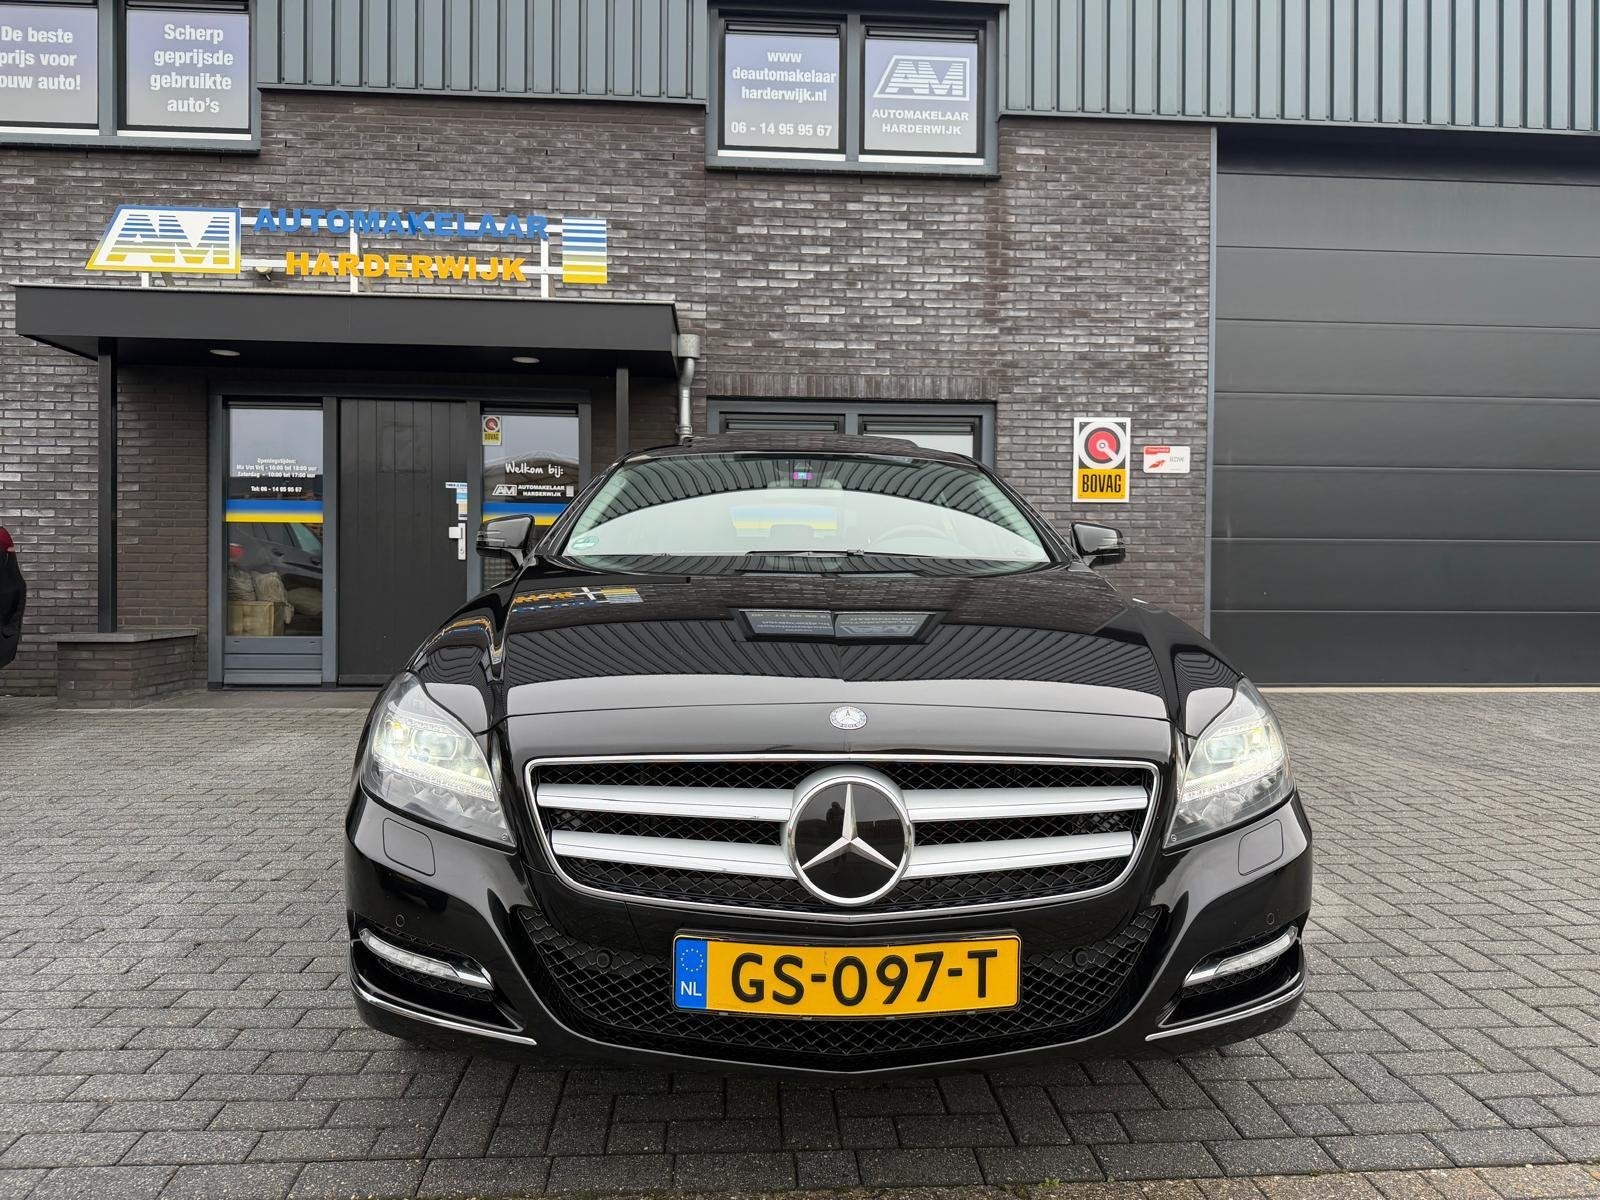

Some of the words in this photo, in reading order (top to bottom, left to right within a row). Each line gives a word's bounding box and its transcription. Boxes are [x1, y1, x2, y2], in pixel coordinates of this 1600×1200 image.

[1, 26, 23, 42] De
[28, 27, 73, 43] beste
[164, 24, 224, 43] Scherp
[0, 50, 35, 67] prijs
[40, 54, 77, 66] voor
[154, 50, 234, 67] geprijsde
[767, 51, 802, 63] www
[0, 75, 33, 89] ouw
[38, 75, 81, 90] auto!
[150, 72, 232, 91] gebruikte
[732, 67, 836, 84] deautomakelaar
[741, 86, 827, 103] harderwijk.nl
[167, 97, 220, 113] auto's
[872, 109, 969, 121] AUTOMAKELAAR
[731, 121, 747, 134] 06
[760, 122, 775, 135] 14
[778, 122, 794, 136] 95
[797, 123, 813, 136] 95
[817, 123, 832, 137] 67
[882, 123, 962, 135] HARDERWIJK
[254, 207, 549, 239] AUTOMAKELAAR
[286, 251, 526, 281] HARDERWIJK
[505, 461, 544, 474] Welkom
[548, 464, 564, 478] bij:
[1082, 474, 1122, 493] BOVAG
[731, 949, 998, 1007] GS-097-T
[680, 981, 702, 996] NL
